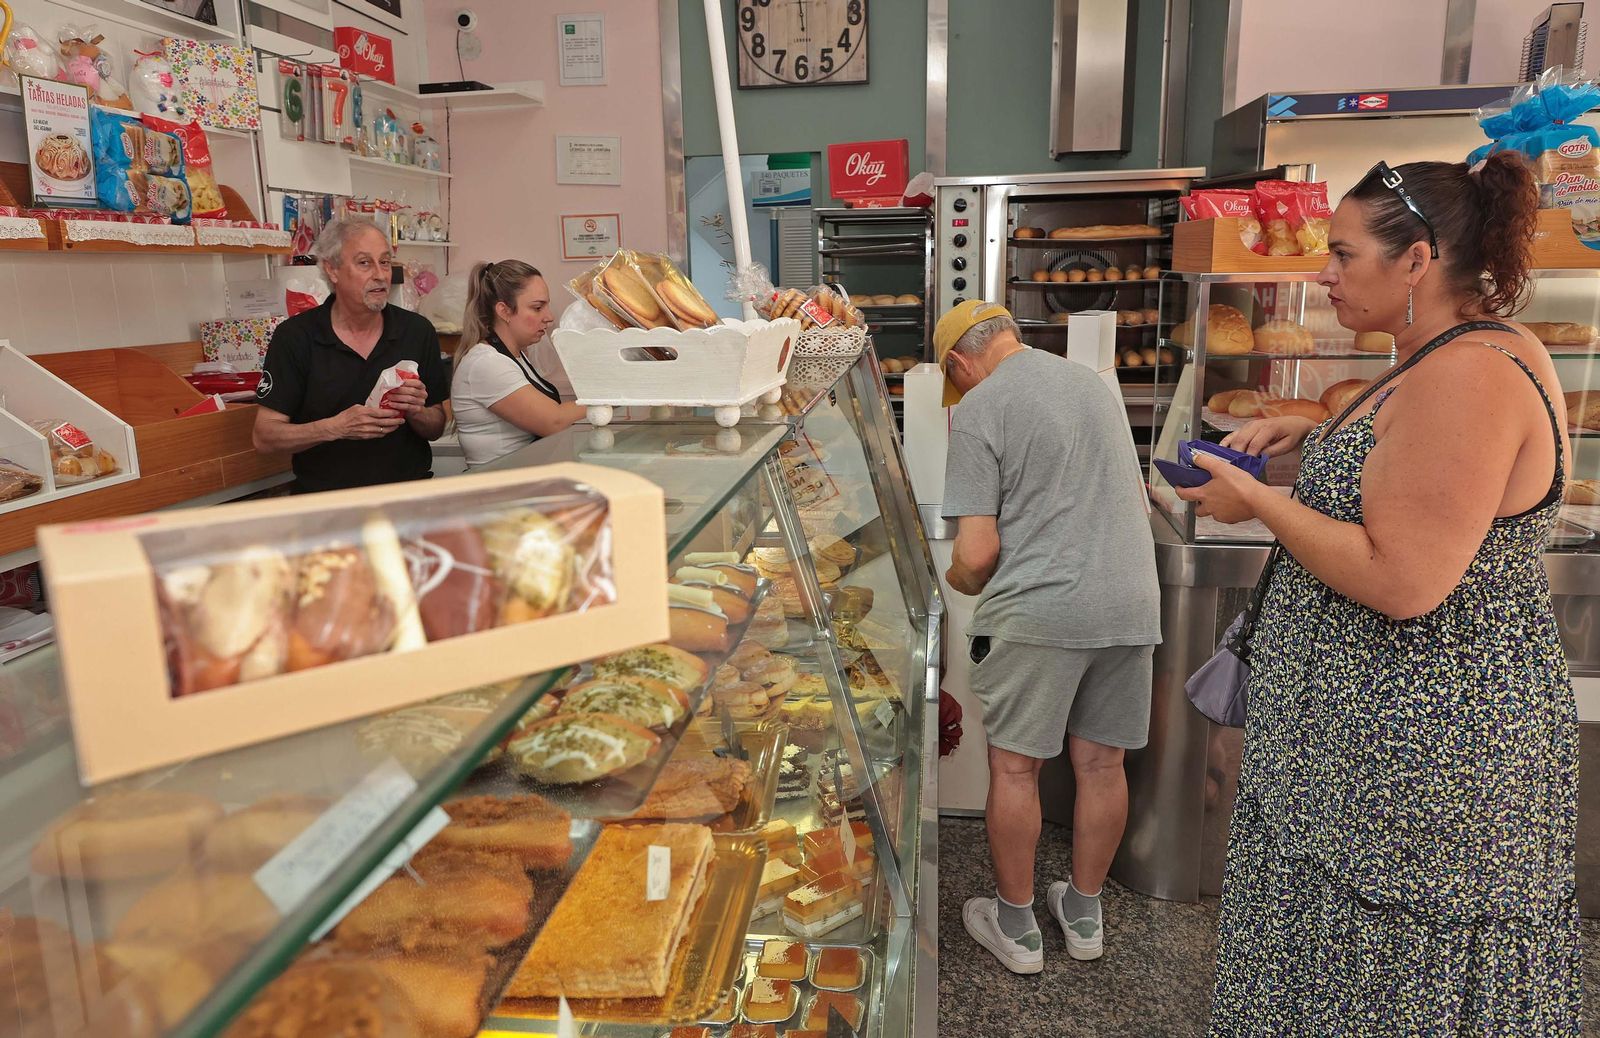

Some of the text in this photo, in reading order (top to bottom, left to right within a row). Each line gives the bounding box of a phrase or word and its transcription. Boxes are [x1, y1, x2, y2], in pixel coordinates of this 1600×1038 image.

[741, 7, 755, 32] 9
[752, 33, 765, 58] 8
[837, 28, 851, 52] 4
[362, 42, 385, 71] Okay
[772, 49, 786, 74] 7
[795, 55, 808, 80] 6
[820, 48, 833, 73] 5
[28, 87, 86, 109] TARTAS HELADAS
[1561, 144, 1588, 154] GOTRI
[773, 170, 809, 179] PAQUETES
[845, 151, 887, 186] Okay
[1555, 173, 1583, 187] Pan
[1555, 180, 1599, 197] de molde
[1223, 200, 1252, 216] Okay
